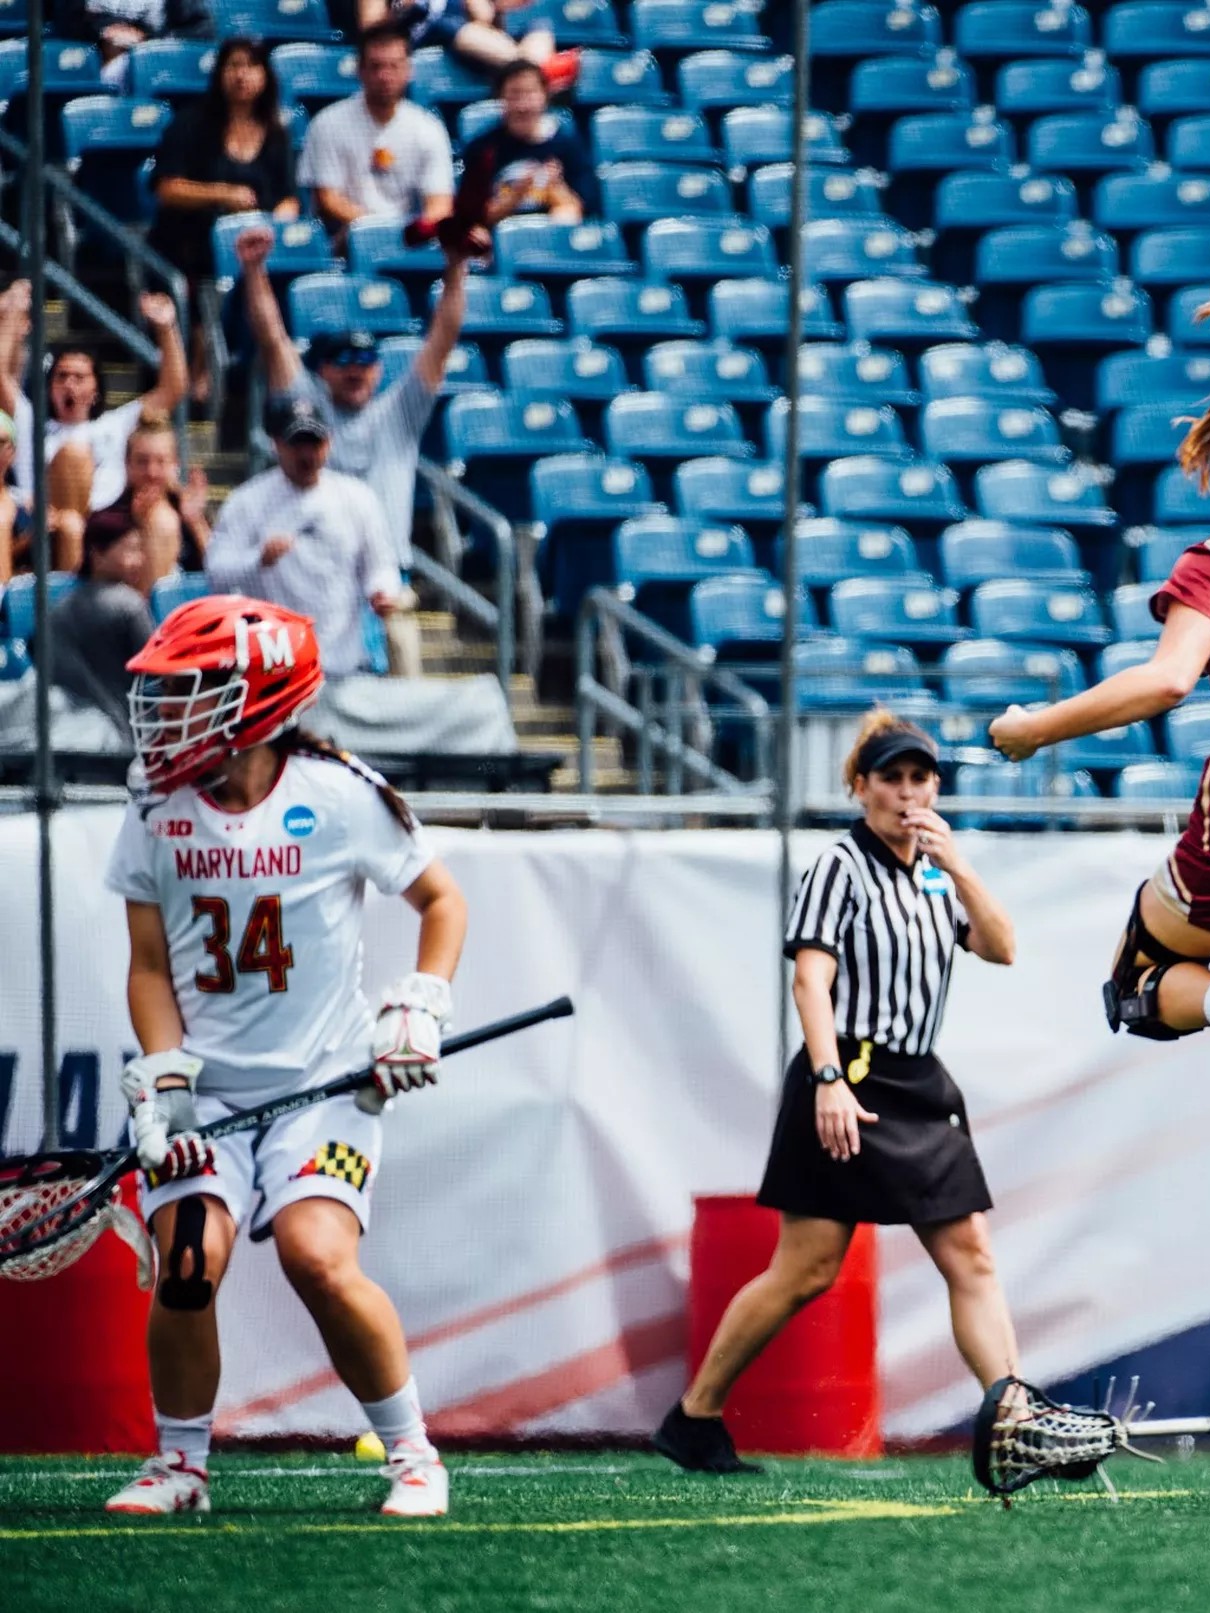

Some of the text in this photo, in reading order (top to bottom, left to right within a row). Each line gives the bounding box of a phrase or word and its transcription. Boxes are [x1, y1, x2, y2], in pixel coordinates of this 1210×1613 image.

[256, 626, 296, 674] M
[175, 845, 302, 880] MARYLAND
[191, 893, 294, 993] 34
